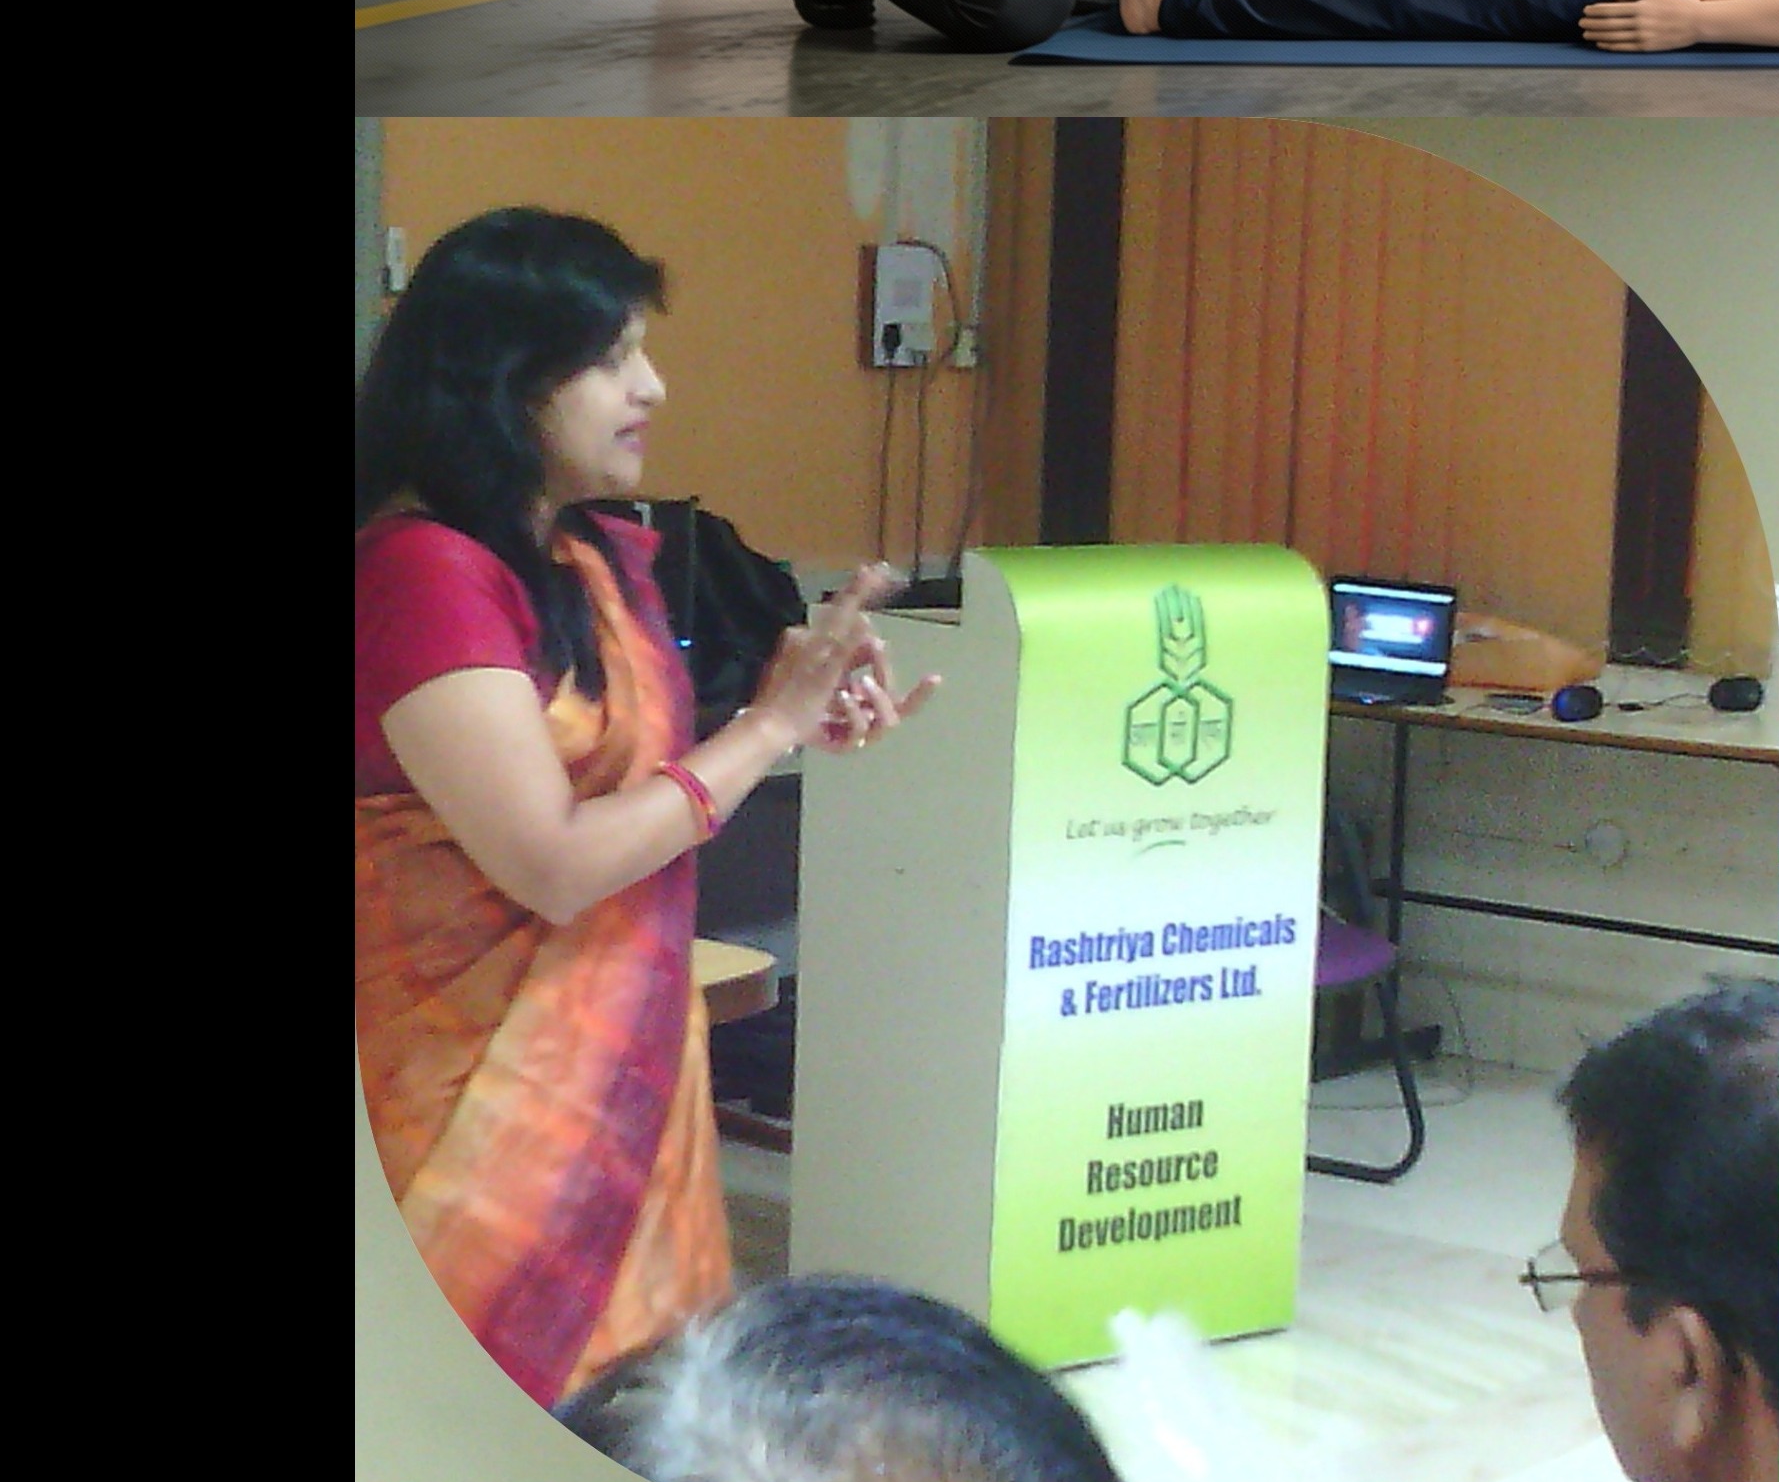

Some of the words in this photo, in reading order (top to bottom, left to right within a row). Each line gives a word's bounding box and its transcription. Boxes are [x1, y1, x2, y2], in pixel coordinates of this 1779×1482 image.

[1029, 928, 1155, 969] Rashtriya
[1161, 914, 1296, 956] Chemicals
[1060, 988, 1078, 1017] &
[1084, 973, 1213, 1014] Fertilizers
[1220, 964, 1262, 999] Ltd.
[1106, 1099, 1204, 1140] Human
[1086, 1149, 1219, 1196] Resource
[1057, 1194, 1242, 1254] Development
